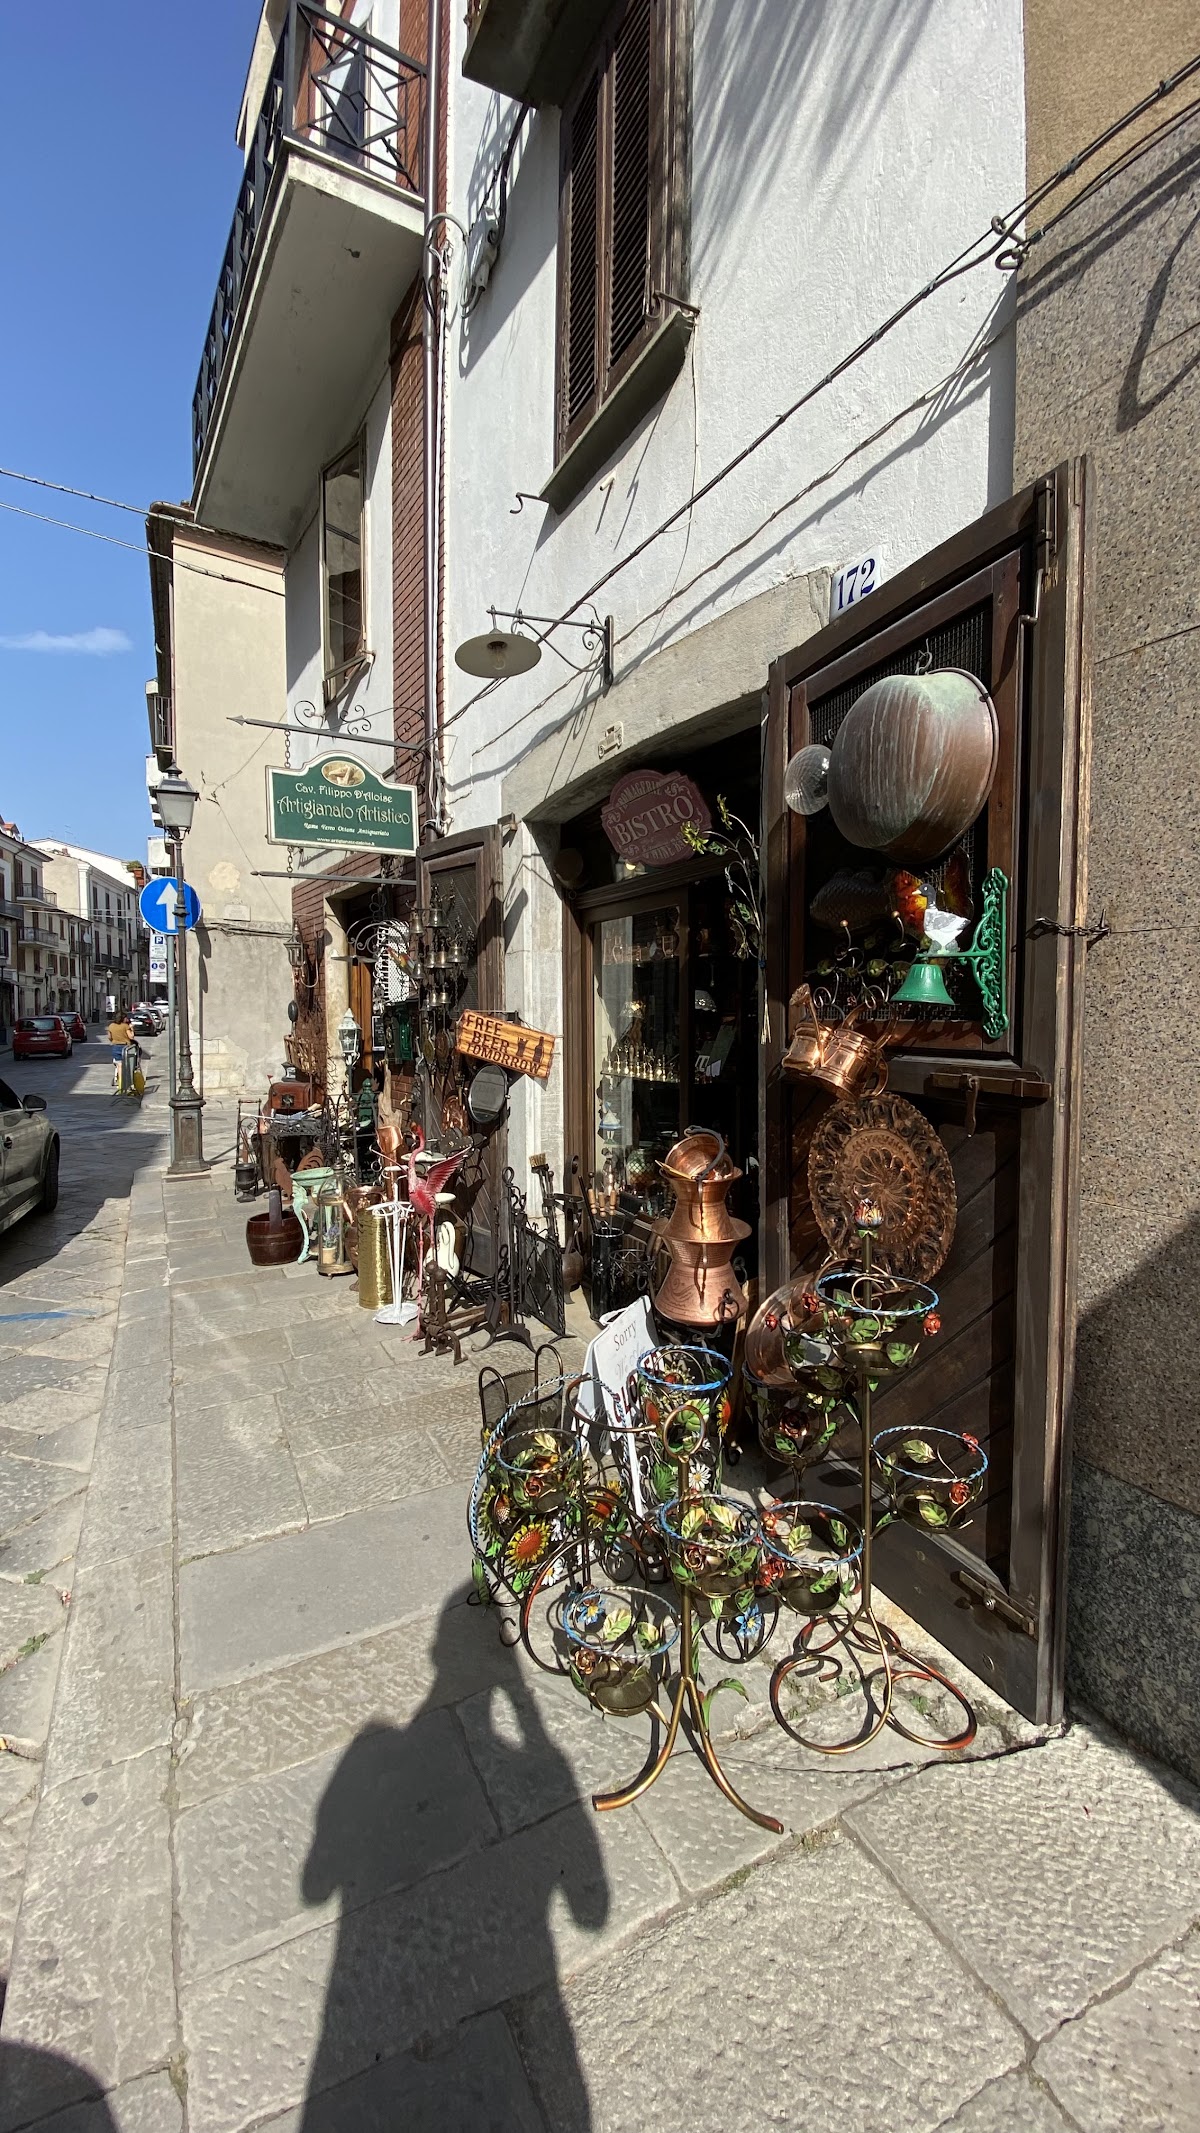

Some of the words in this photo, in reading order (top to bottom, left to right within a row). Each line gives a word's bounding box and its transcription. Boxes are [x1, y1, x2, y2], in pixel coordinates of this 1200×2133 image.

[838, 558, 875, 611] 172
[295, 782, 316, 794] Cav.
[319, 785, 352, 799] Filippo
[353, 789, 393, 803] D'Aloise
[616, 780, 662, 813] FROMAGERIE
[276, 795, 354, 820] Artigianato
[355, 804, 411, 825] Artistico
[612, 795, 694, 846] BISTRO
[465, 1014, 503, 1037] FREE
[466, 1041, 541, 1075] TOMORROW
[471, 1030, 510, 1054] BEER
[613, 1320, 637, 1352] Sorry
[612, 1351, 660, 1424] CLOED
